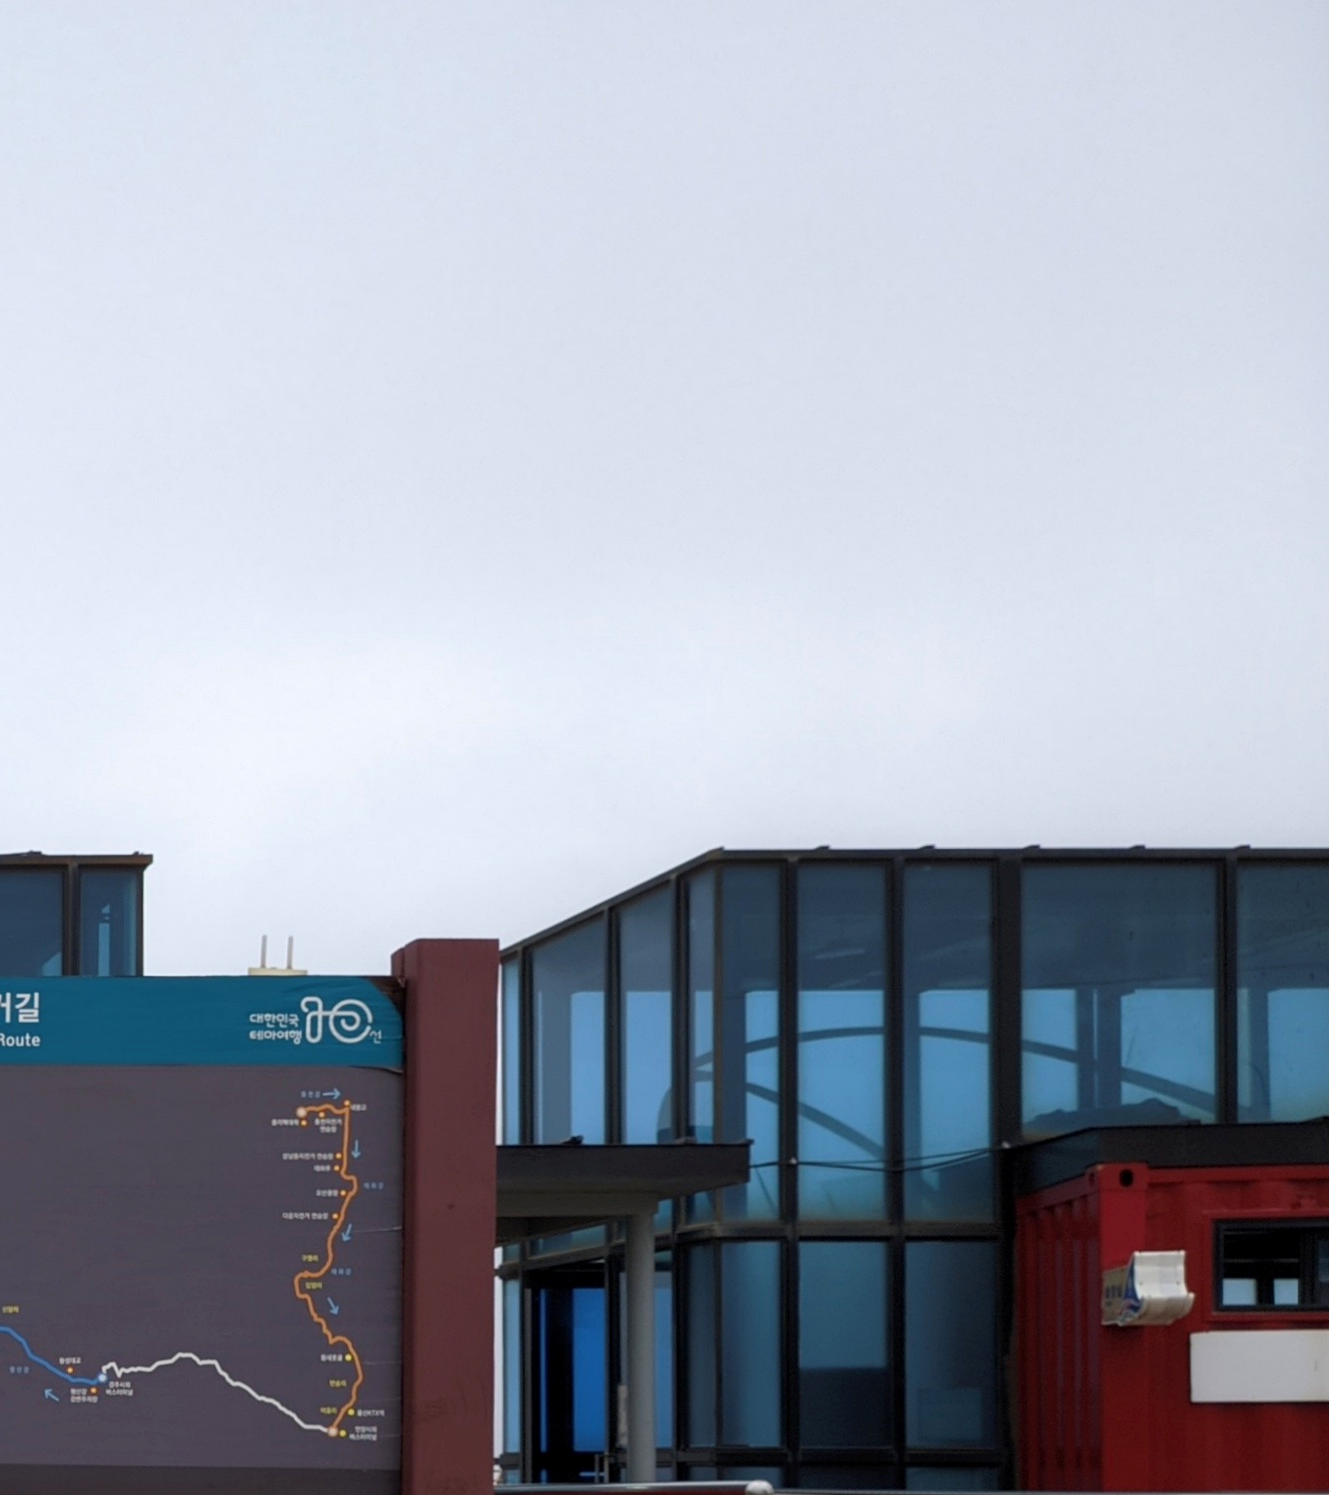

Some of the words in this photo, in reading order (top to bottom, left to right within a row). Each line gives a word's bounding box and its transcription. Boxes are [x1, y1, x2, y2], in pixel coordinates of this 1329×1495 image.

[249, 1013, 299, 1027] 대한민국
[248, 1029, 302, 1045] 테마여행
[369, 1029, 381, 1044] 선
